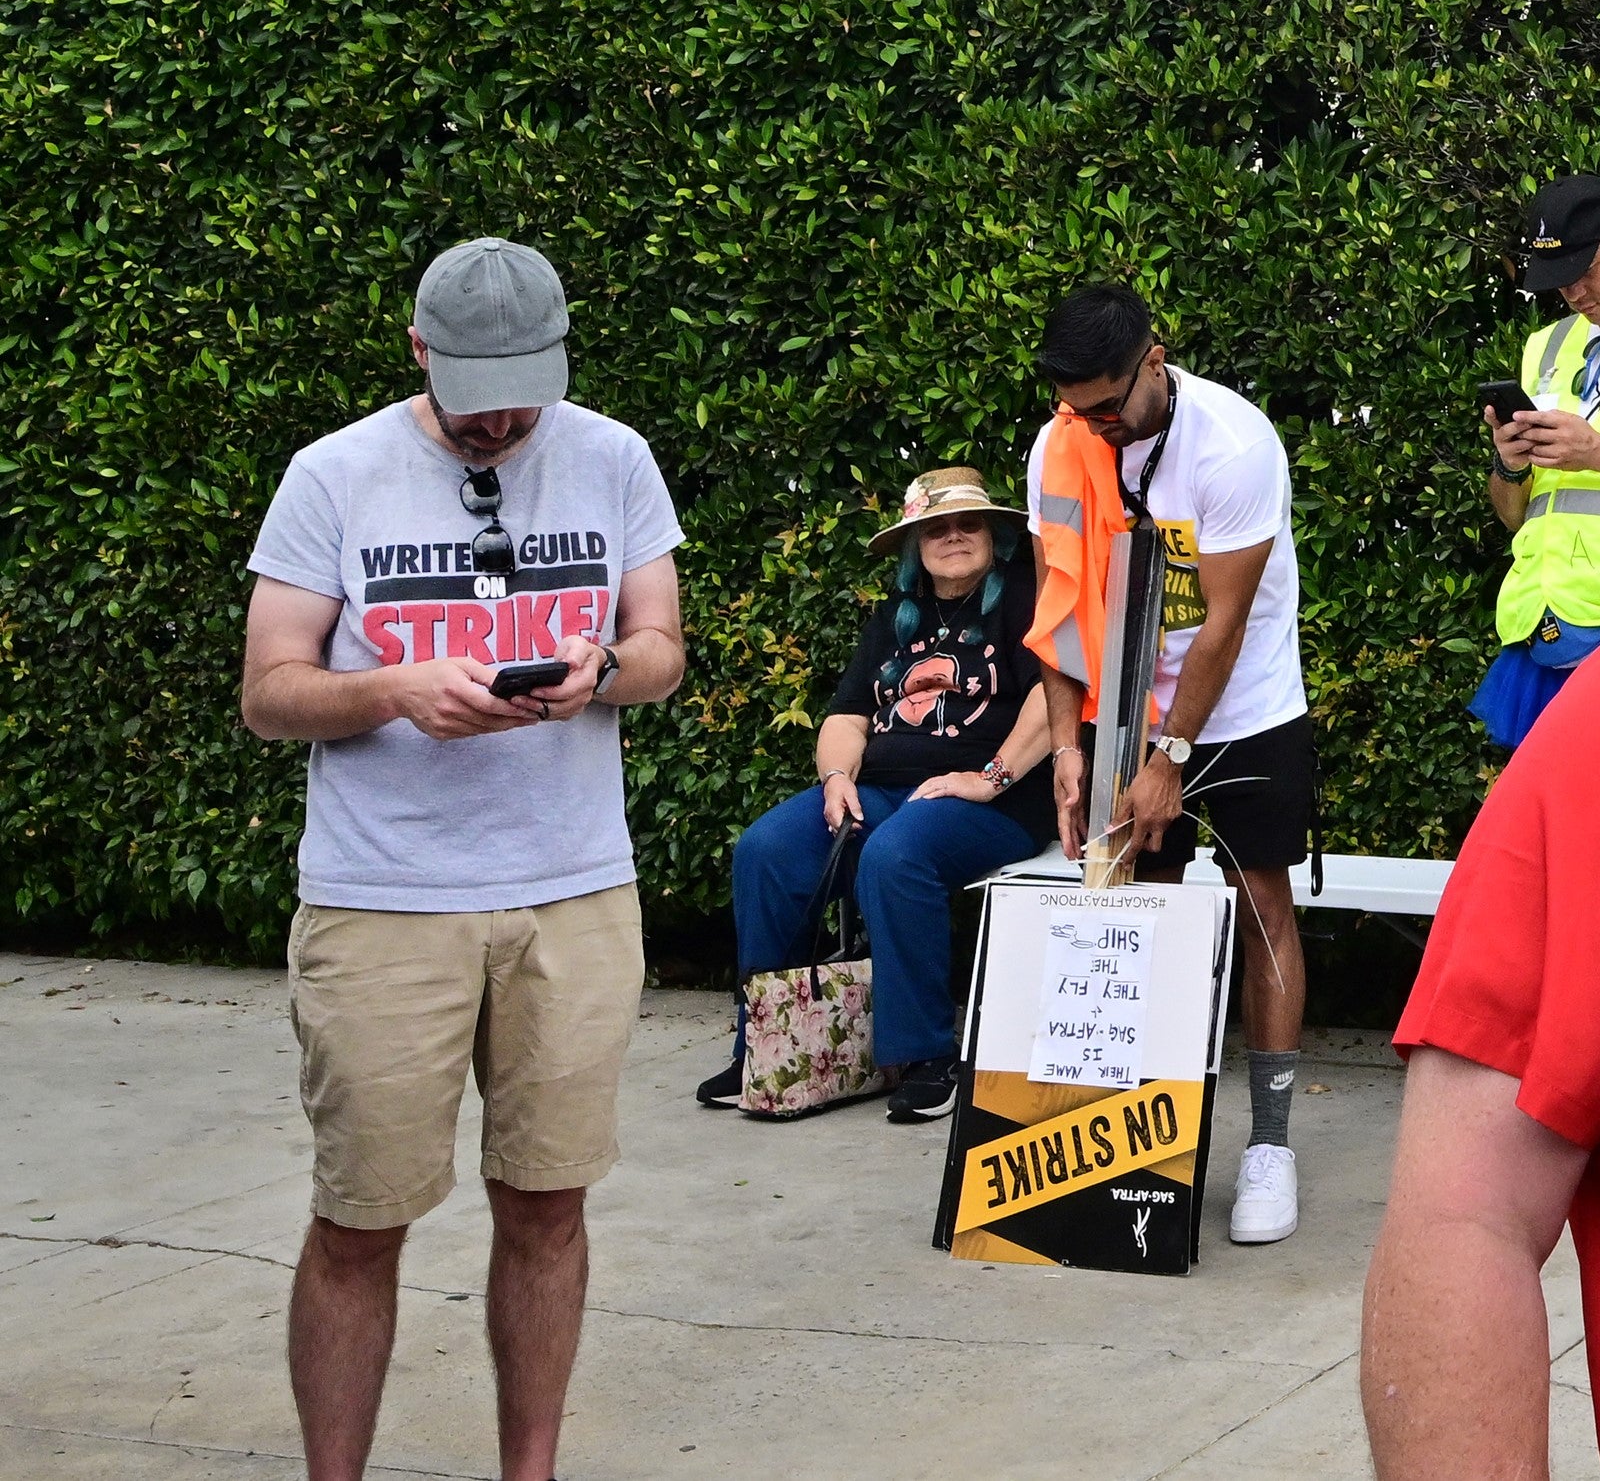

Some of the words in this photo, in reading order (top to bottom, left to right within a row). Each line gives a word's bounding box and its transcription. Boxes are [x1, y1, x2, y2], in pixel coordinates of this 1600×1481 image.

[361, 543, 474, 578] WRITE
[519, 531, 606, 565] GUILD
[473, 576, 507, 599] ON
[363, 590, 610, 666] STRIKE!
[1040, 893, 1167, 909] #SAGAFTRASTRONG
[1097, 927, 1140, 953] SHIP
[1058, 977, 1088, 996] FLY
[1103, 980, 1140, 1000] THEY
[1082, 1048, 1103, 1061] IS
[1043, 1063, 1083, 1080] NAME
[1098, 1066, 1134, 1085] THEIR
[1122, 1092, 1179, 1157] ON
[981, 1115, 1116, 1209] STRIKE
